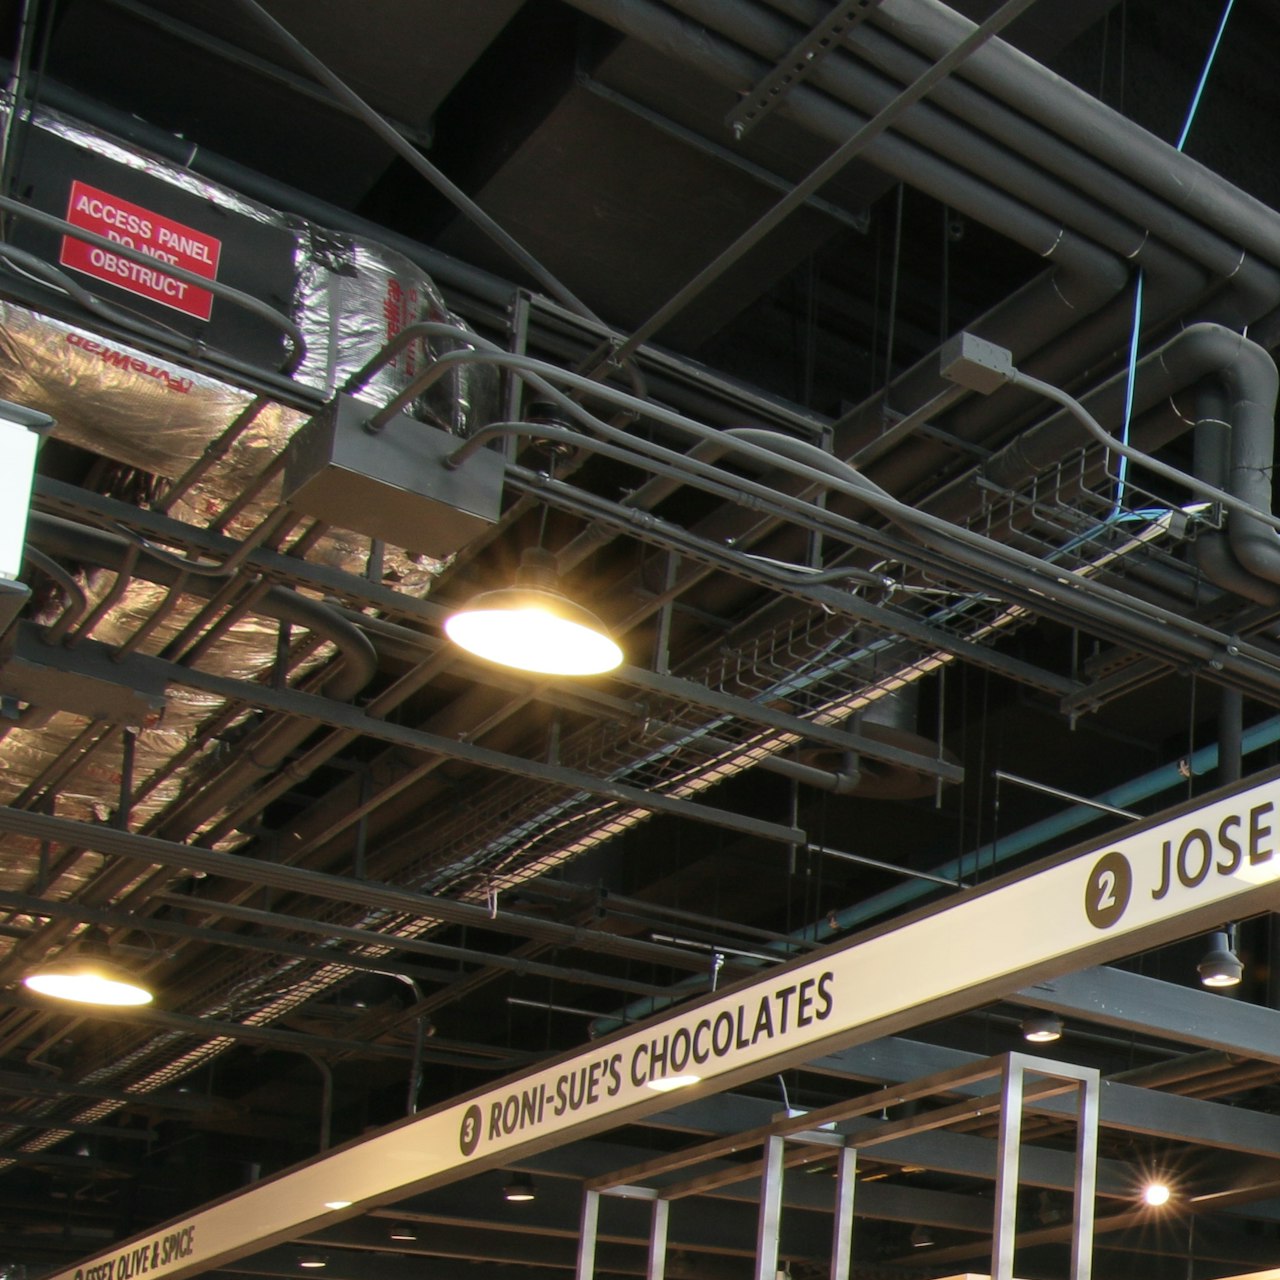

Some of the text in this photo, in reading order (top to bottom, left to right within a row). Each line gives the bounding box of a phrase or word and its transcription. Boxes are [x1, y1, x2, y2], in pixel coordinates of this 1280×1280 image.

[76, 195, 213, 265] ACCESS PANEL
[107, 230, 179, 266] DO NOT
[90, 249, 188, 299] OBSTRUCT
[1096, 873, 1117, 910] 2
[488, 1053, 622, 1141] RONI-SUE'S
[630, 971, 834, 1088] CHOCOLATES
[150, 1241, 159, 1270] &
[161, 1225, 196, 1266] SPICE
